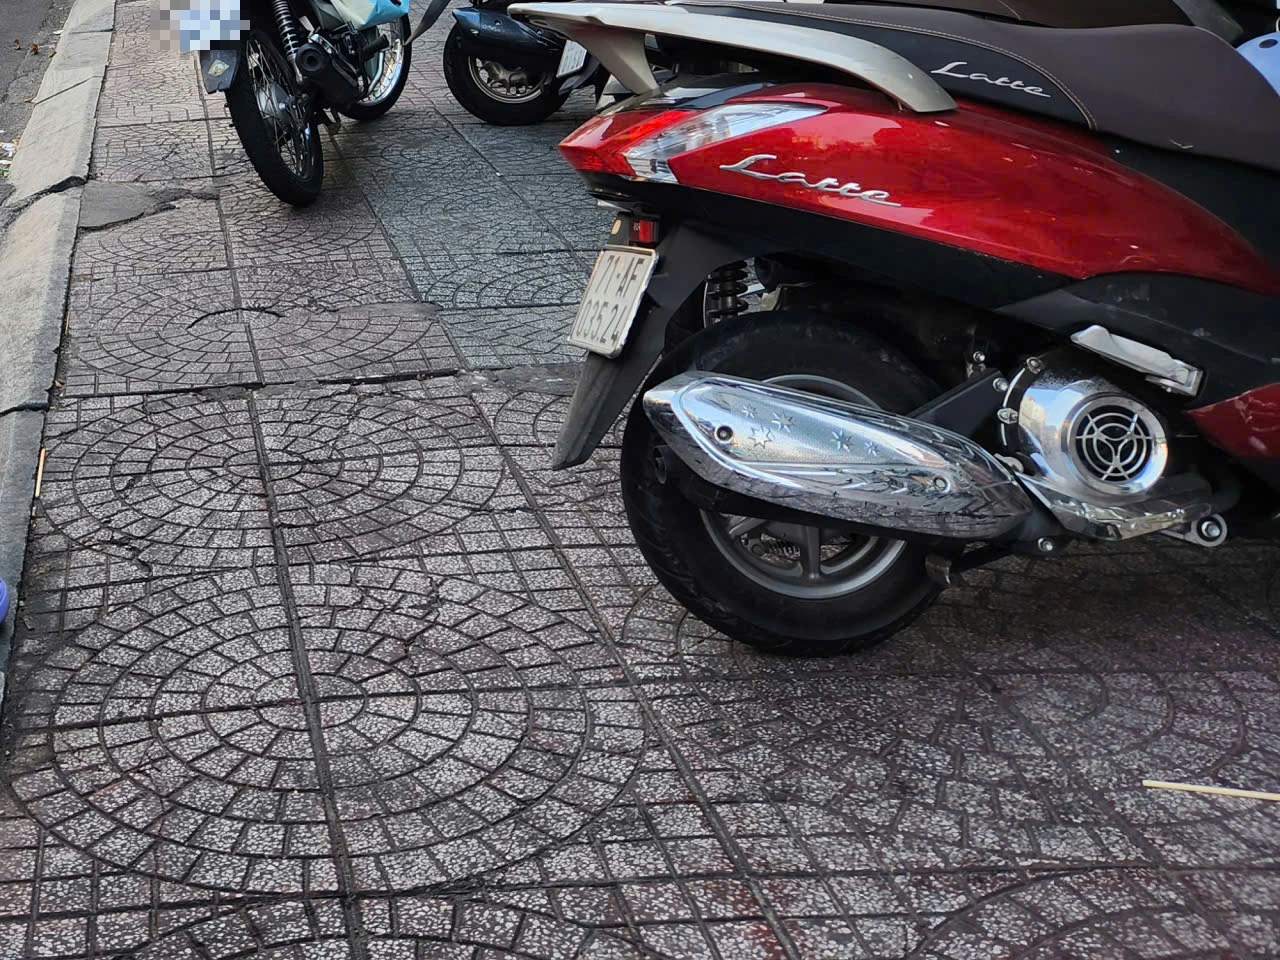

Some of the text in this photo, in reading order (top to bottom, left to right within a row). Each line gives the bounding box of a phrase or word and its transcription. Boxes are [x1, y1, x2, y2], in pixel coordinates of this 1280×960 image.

[931, 61, 1051, 98] Latte
[720, 154, 902, 207] Latte
[595, 254, 645, 299] 71-AF
[575, 299, 627, 345] 035.24
